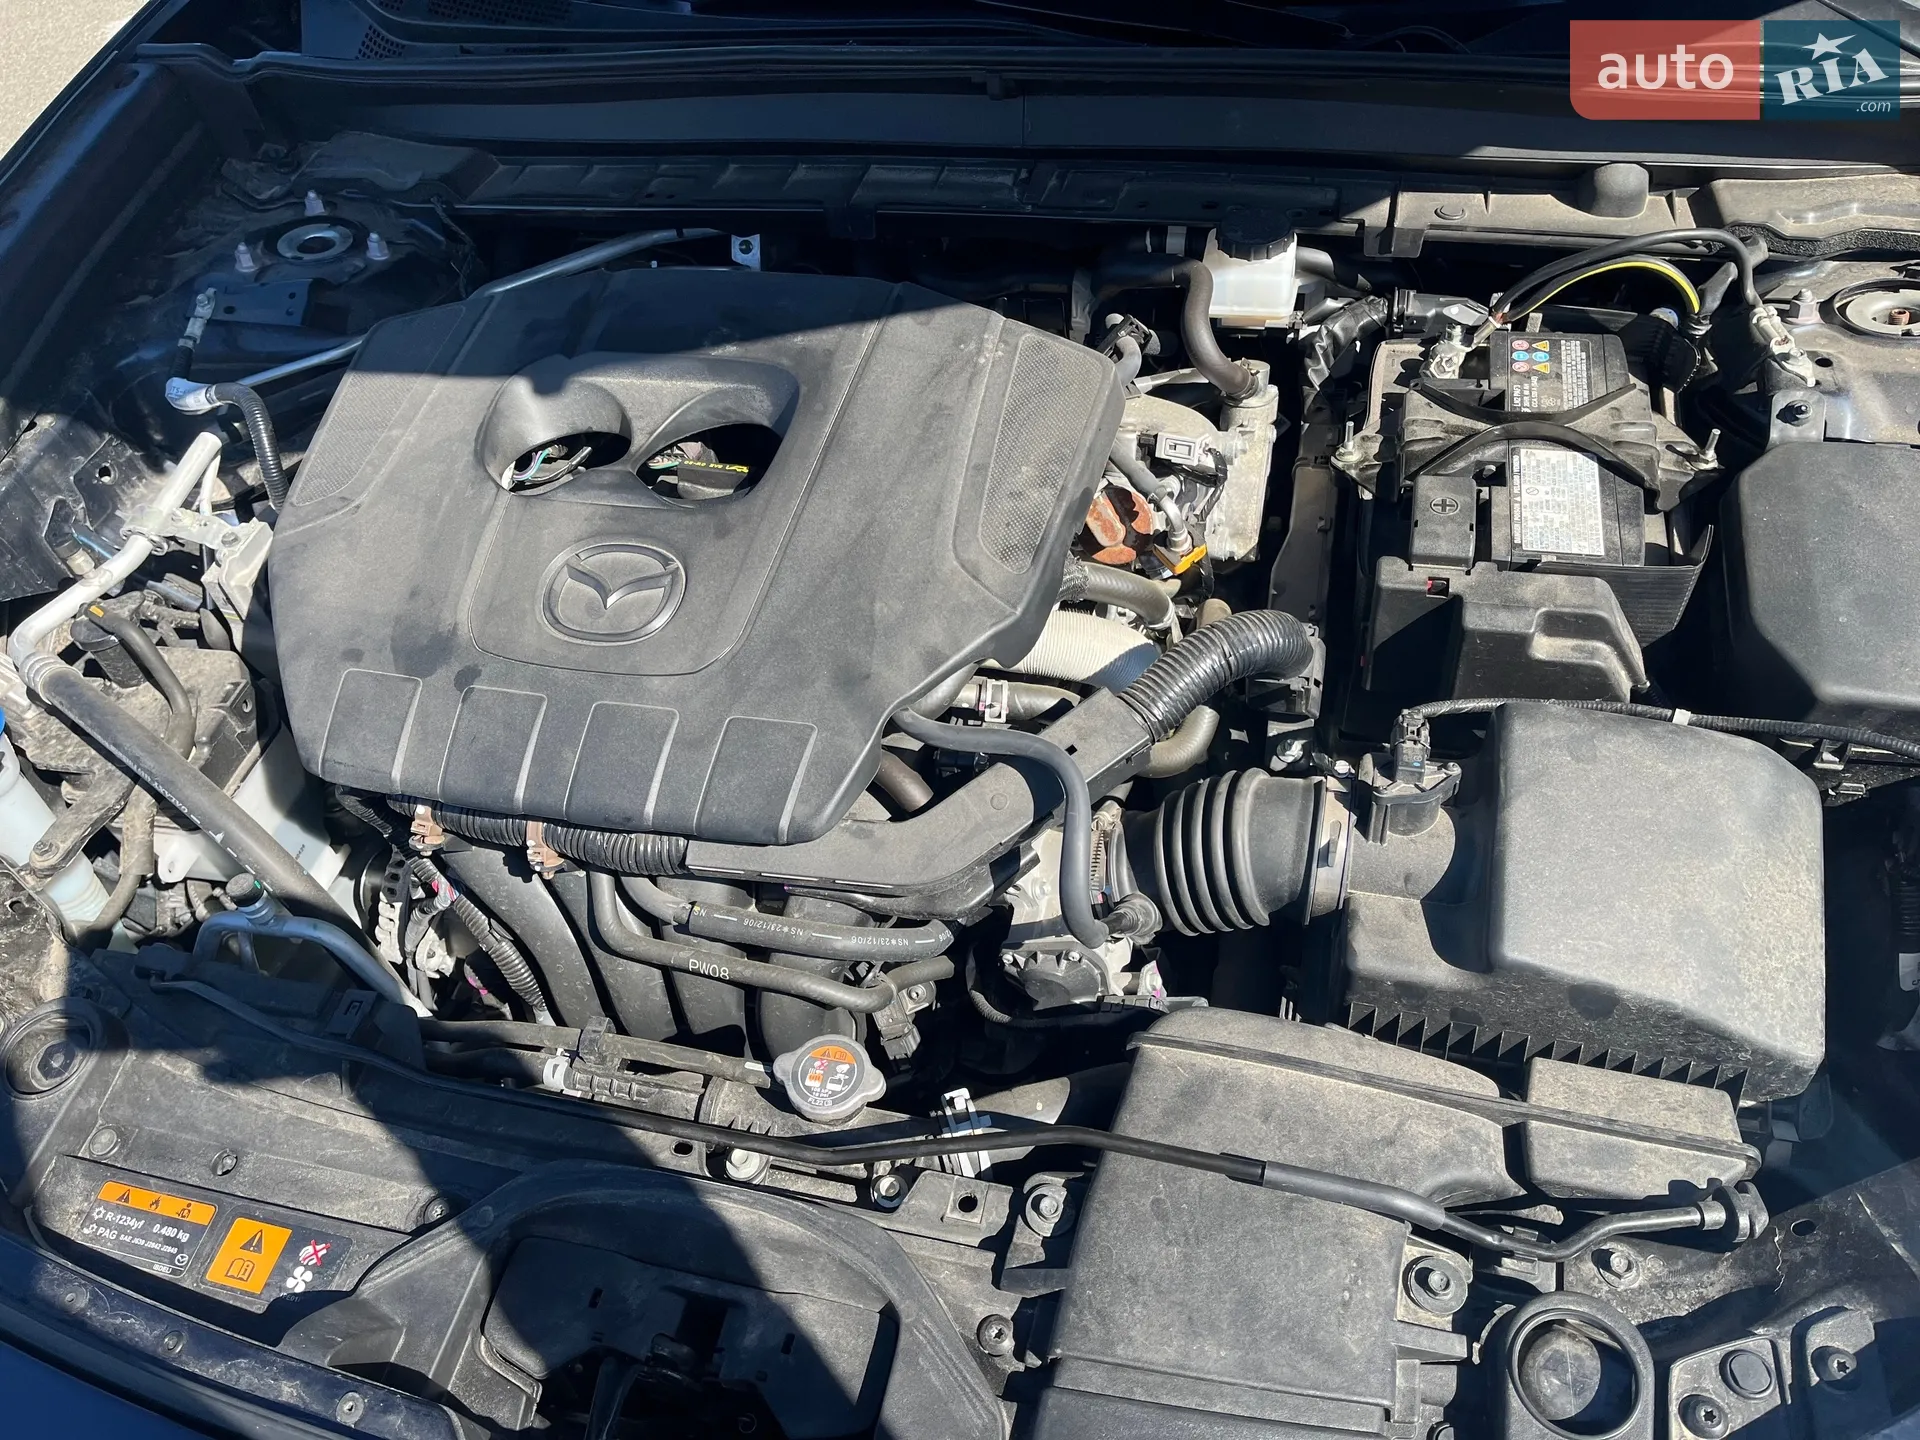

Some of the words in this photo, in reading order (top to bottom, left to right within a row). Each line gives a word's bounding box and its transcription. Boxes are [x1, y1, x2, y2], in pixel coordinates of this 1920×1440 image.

[688, 958, 730, 980] PW08
[96, 1227, 118, 1240] PAG
[119, 1234, 133, 1242] SAE
[105, 1211, 145, 1230] R-1234yf
[152, 1223, 178, 1238] 0.480
[177, 1229, 190, 1243] kg
